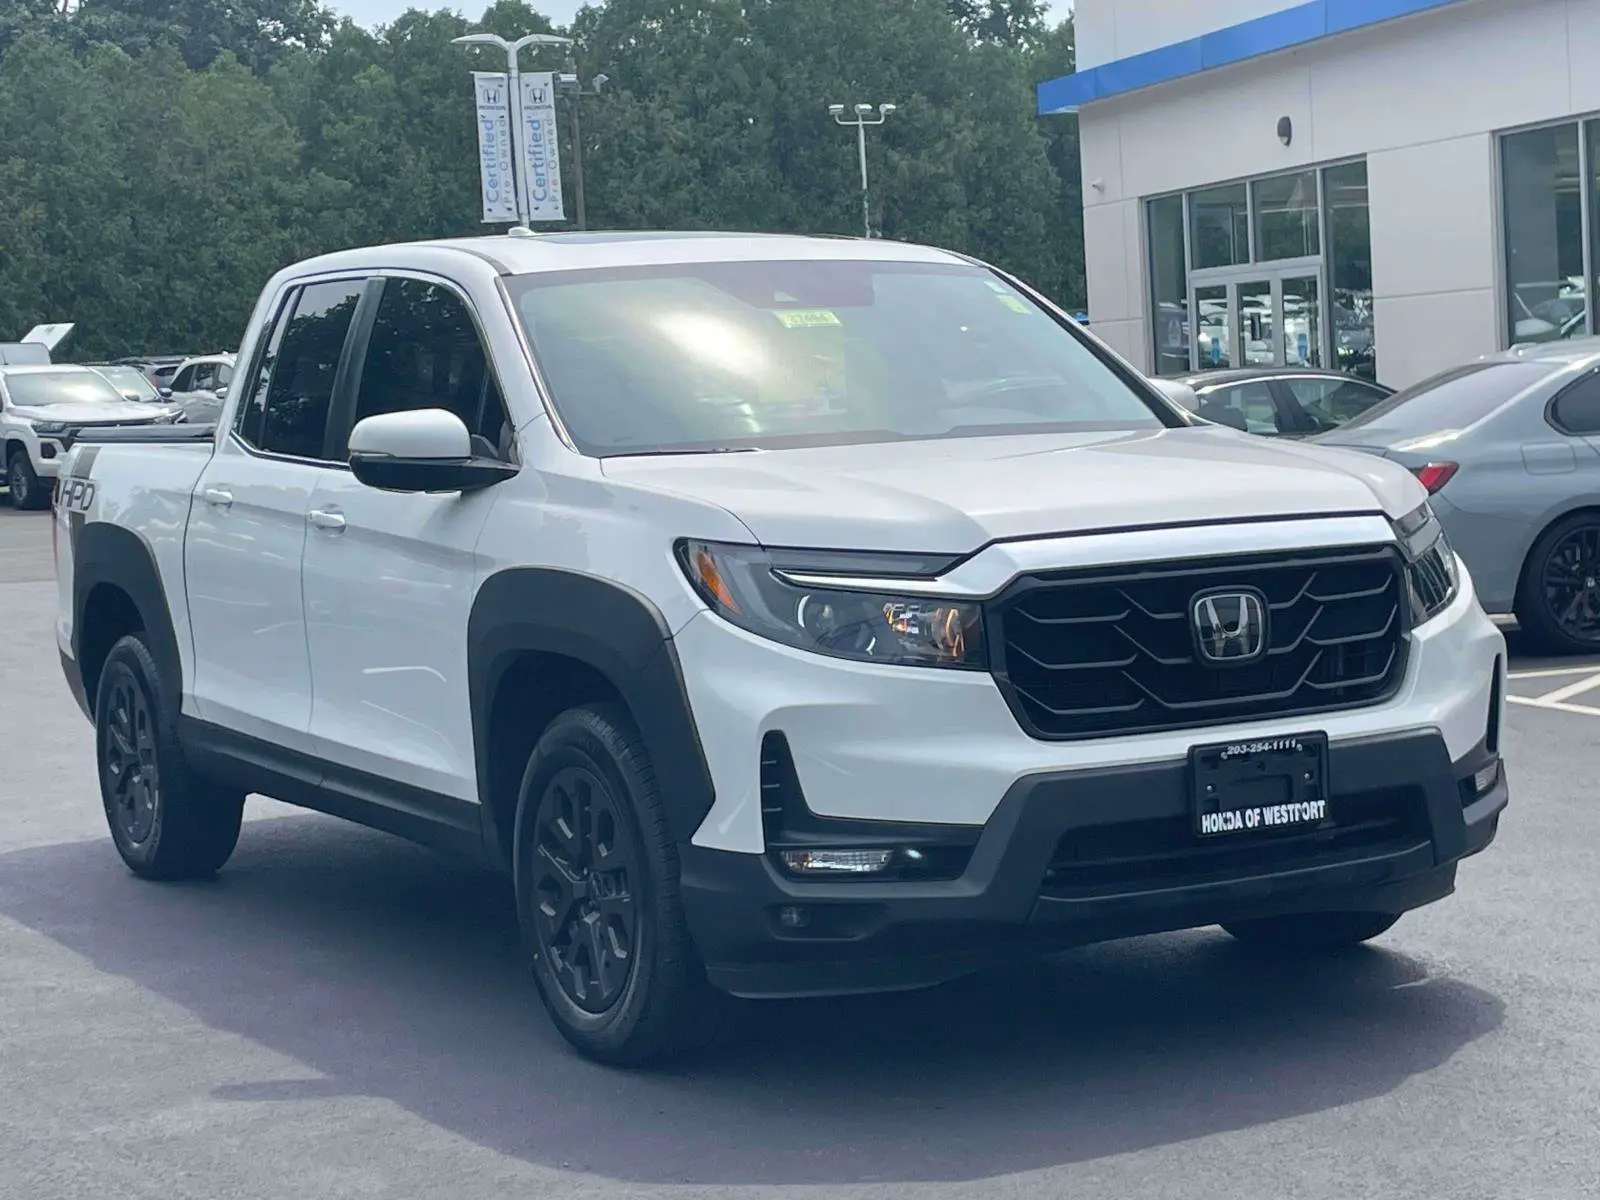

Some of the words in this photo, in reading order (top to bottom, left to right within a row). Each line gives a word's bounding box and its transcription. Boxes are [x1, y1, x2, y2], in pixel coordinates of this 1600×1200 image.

[480, 120, 499, 203] Certified
[500, 120, 512, 203] Pre-Owned
[526, 120, 547, 202] Certified
[60, 480, 95, 511] HPD
[1227, 739, 1296, 755] 203-254-1111
[1202, 811, 1243, 833] HONDA
[1245, 807, 1261, 828] OF
[1263, 800, 1325, 825] WESTPORT
